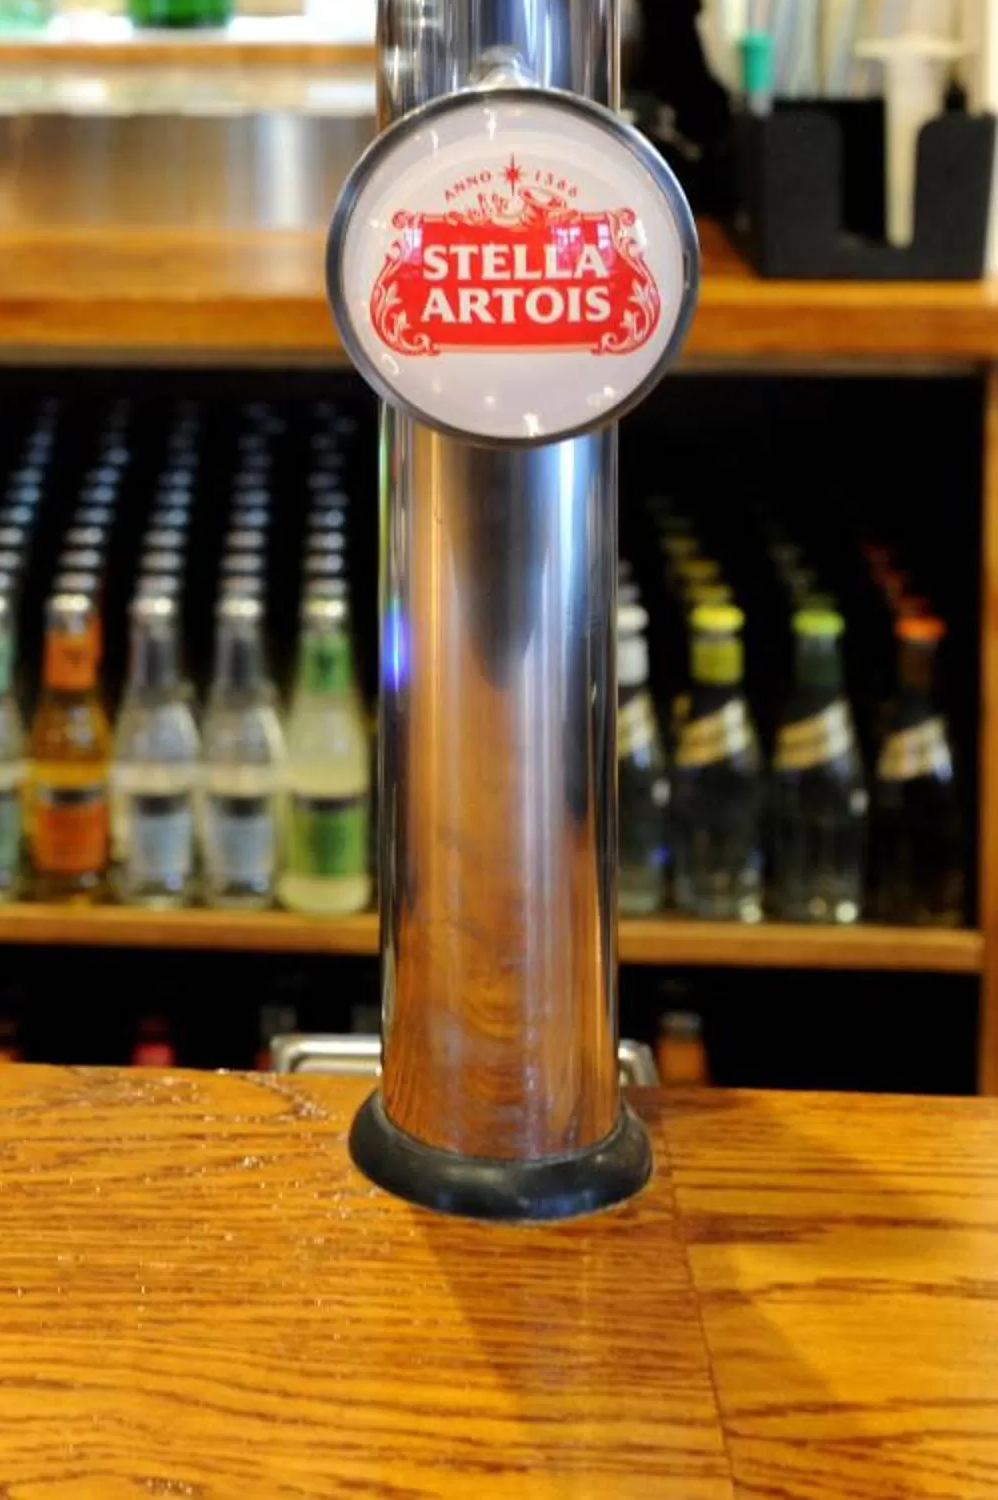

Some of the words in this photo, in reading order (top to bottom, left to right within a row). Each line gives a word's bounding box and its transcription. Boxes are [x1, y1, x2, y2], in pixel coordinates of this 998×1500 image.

[444, 169, 492, 202] ANNO
[422, 243, 610, 281] STELLA
[420, 285, 611, 325] ARTOIS
